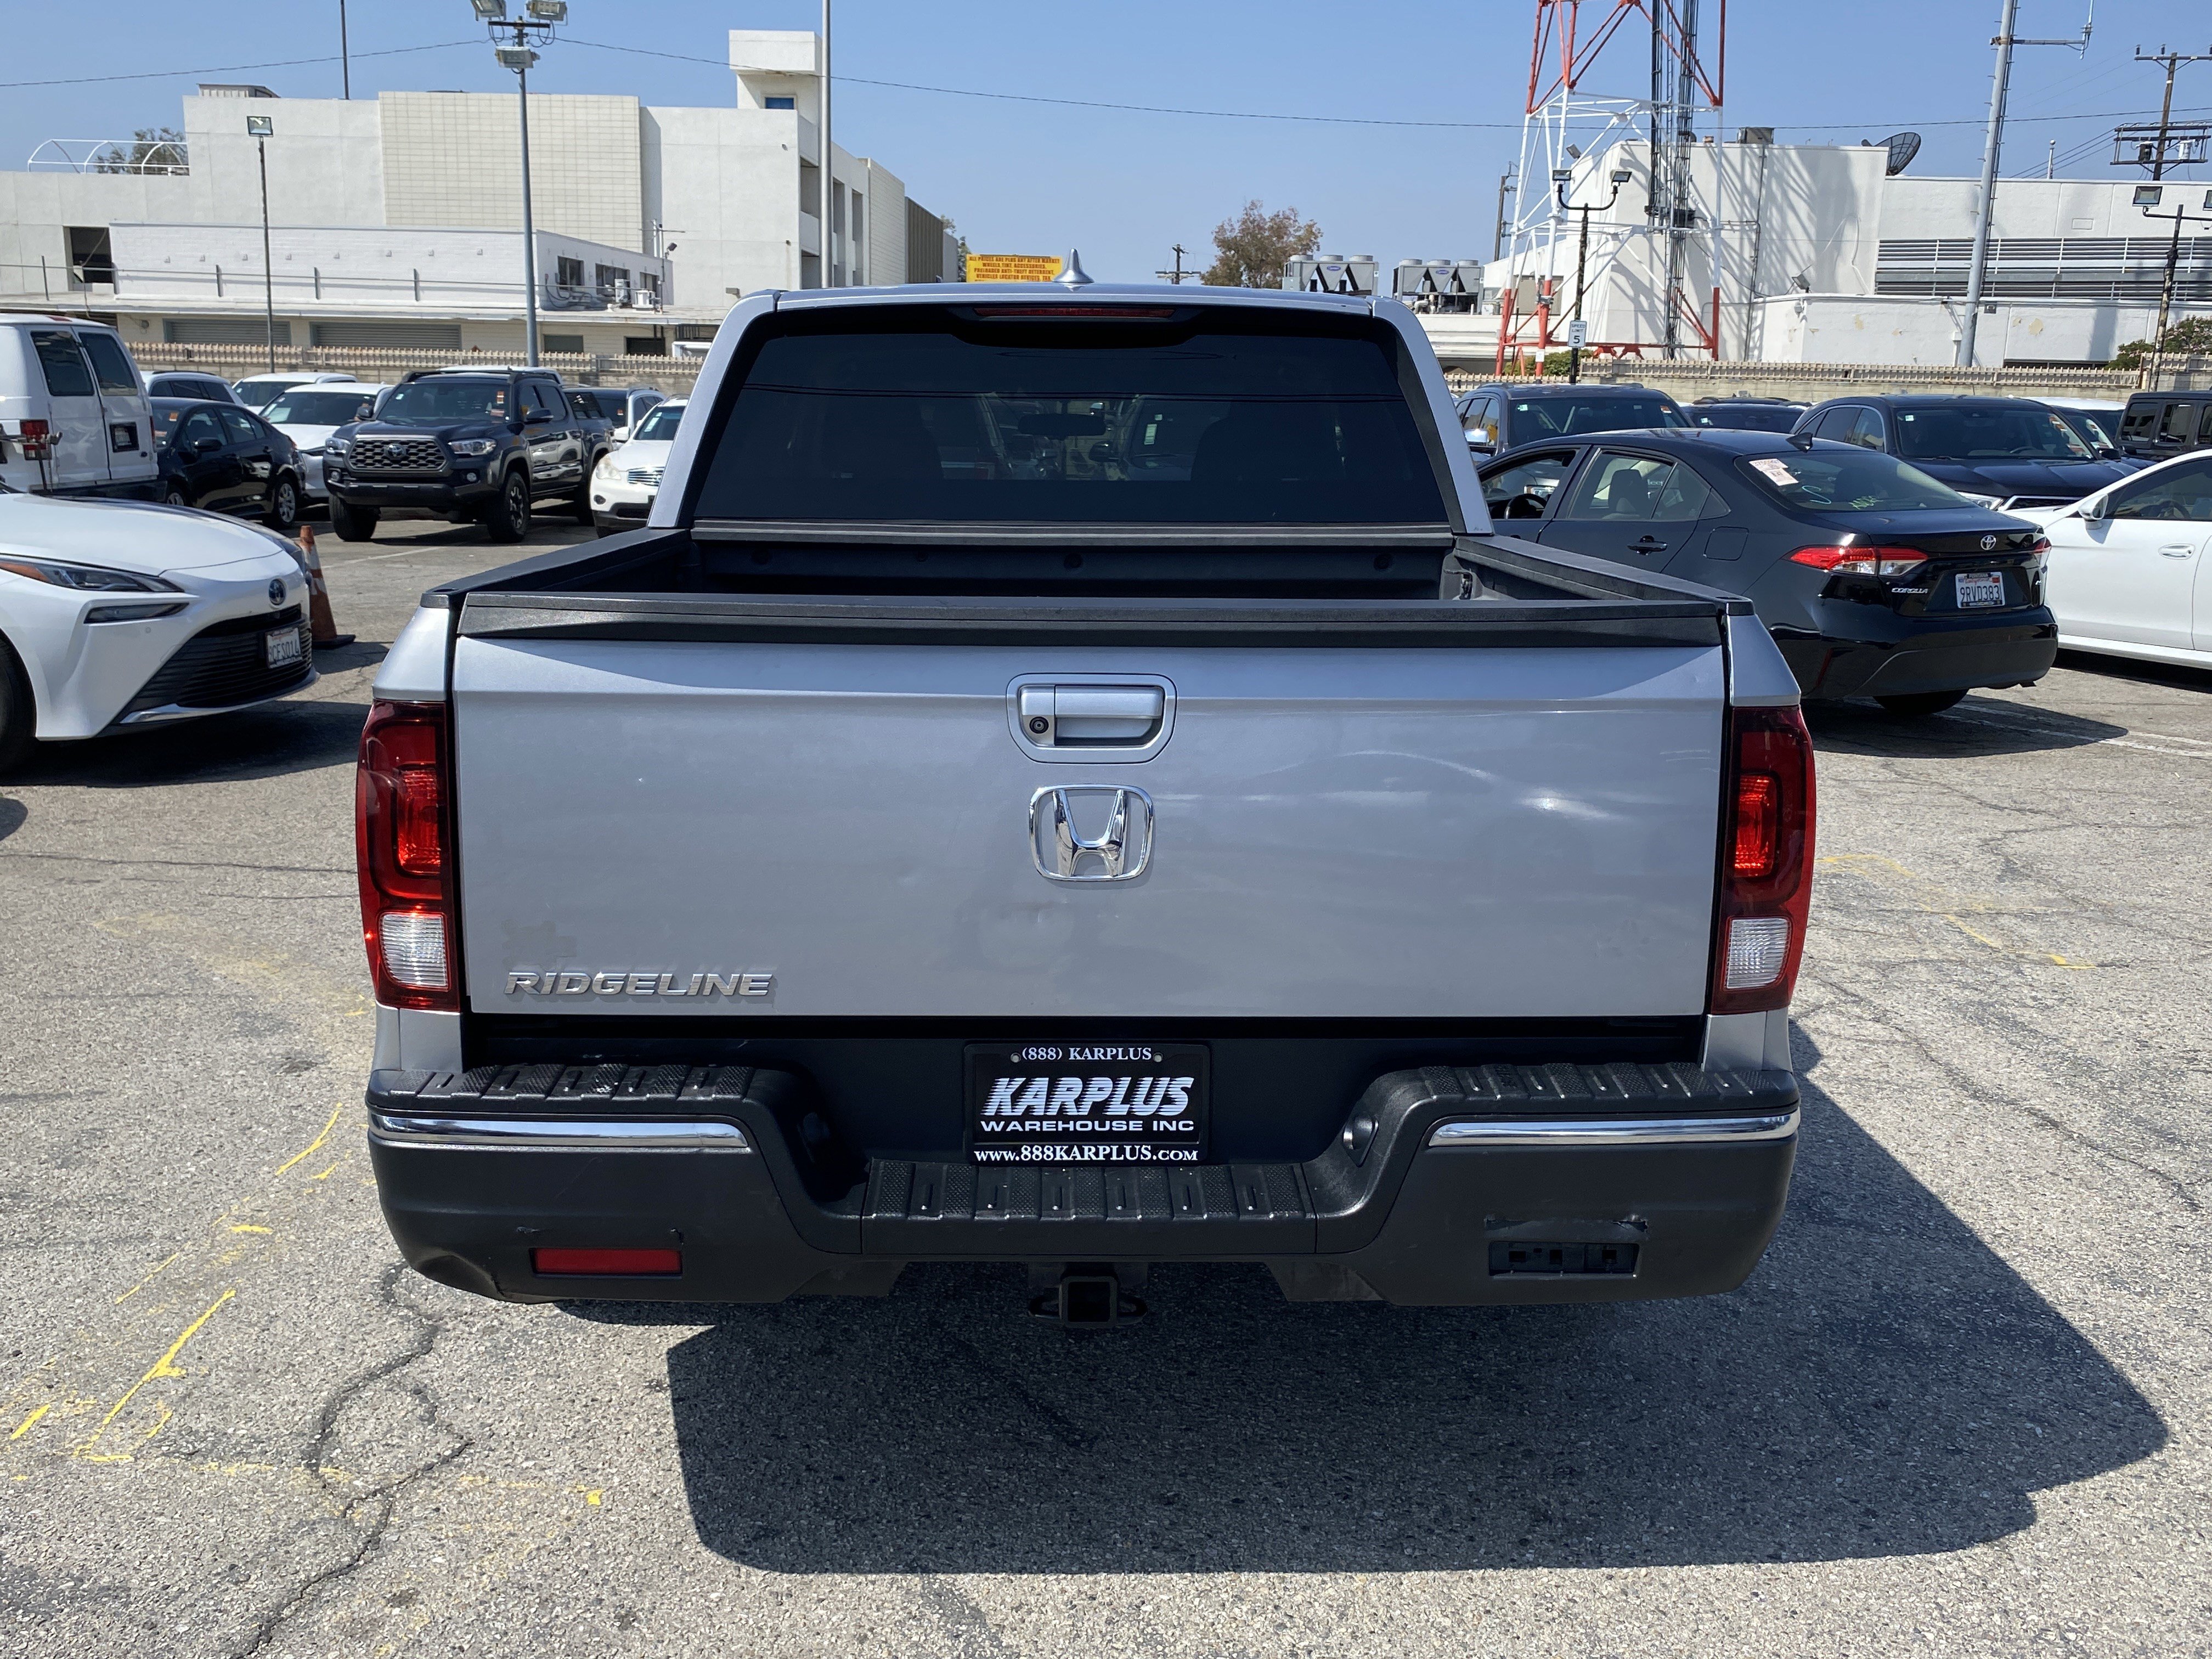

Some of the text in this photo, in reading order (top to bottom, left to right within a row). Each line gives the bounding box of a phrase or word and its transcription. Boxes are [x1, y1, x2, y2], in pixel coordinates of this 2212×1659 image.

[1573, 335, 1580, 344] 5
[1960, 585, 2000, 602] 9RVD383
[504, 972, 774, 996] RIDGELINE
[1022, 1047, 1152, 1061] (888) KARPLUS
[980, 1076, 1195, 1116] KARPLUS
[980, 1120, 1194, 1132] WAREHOUSE INC
